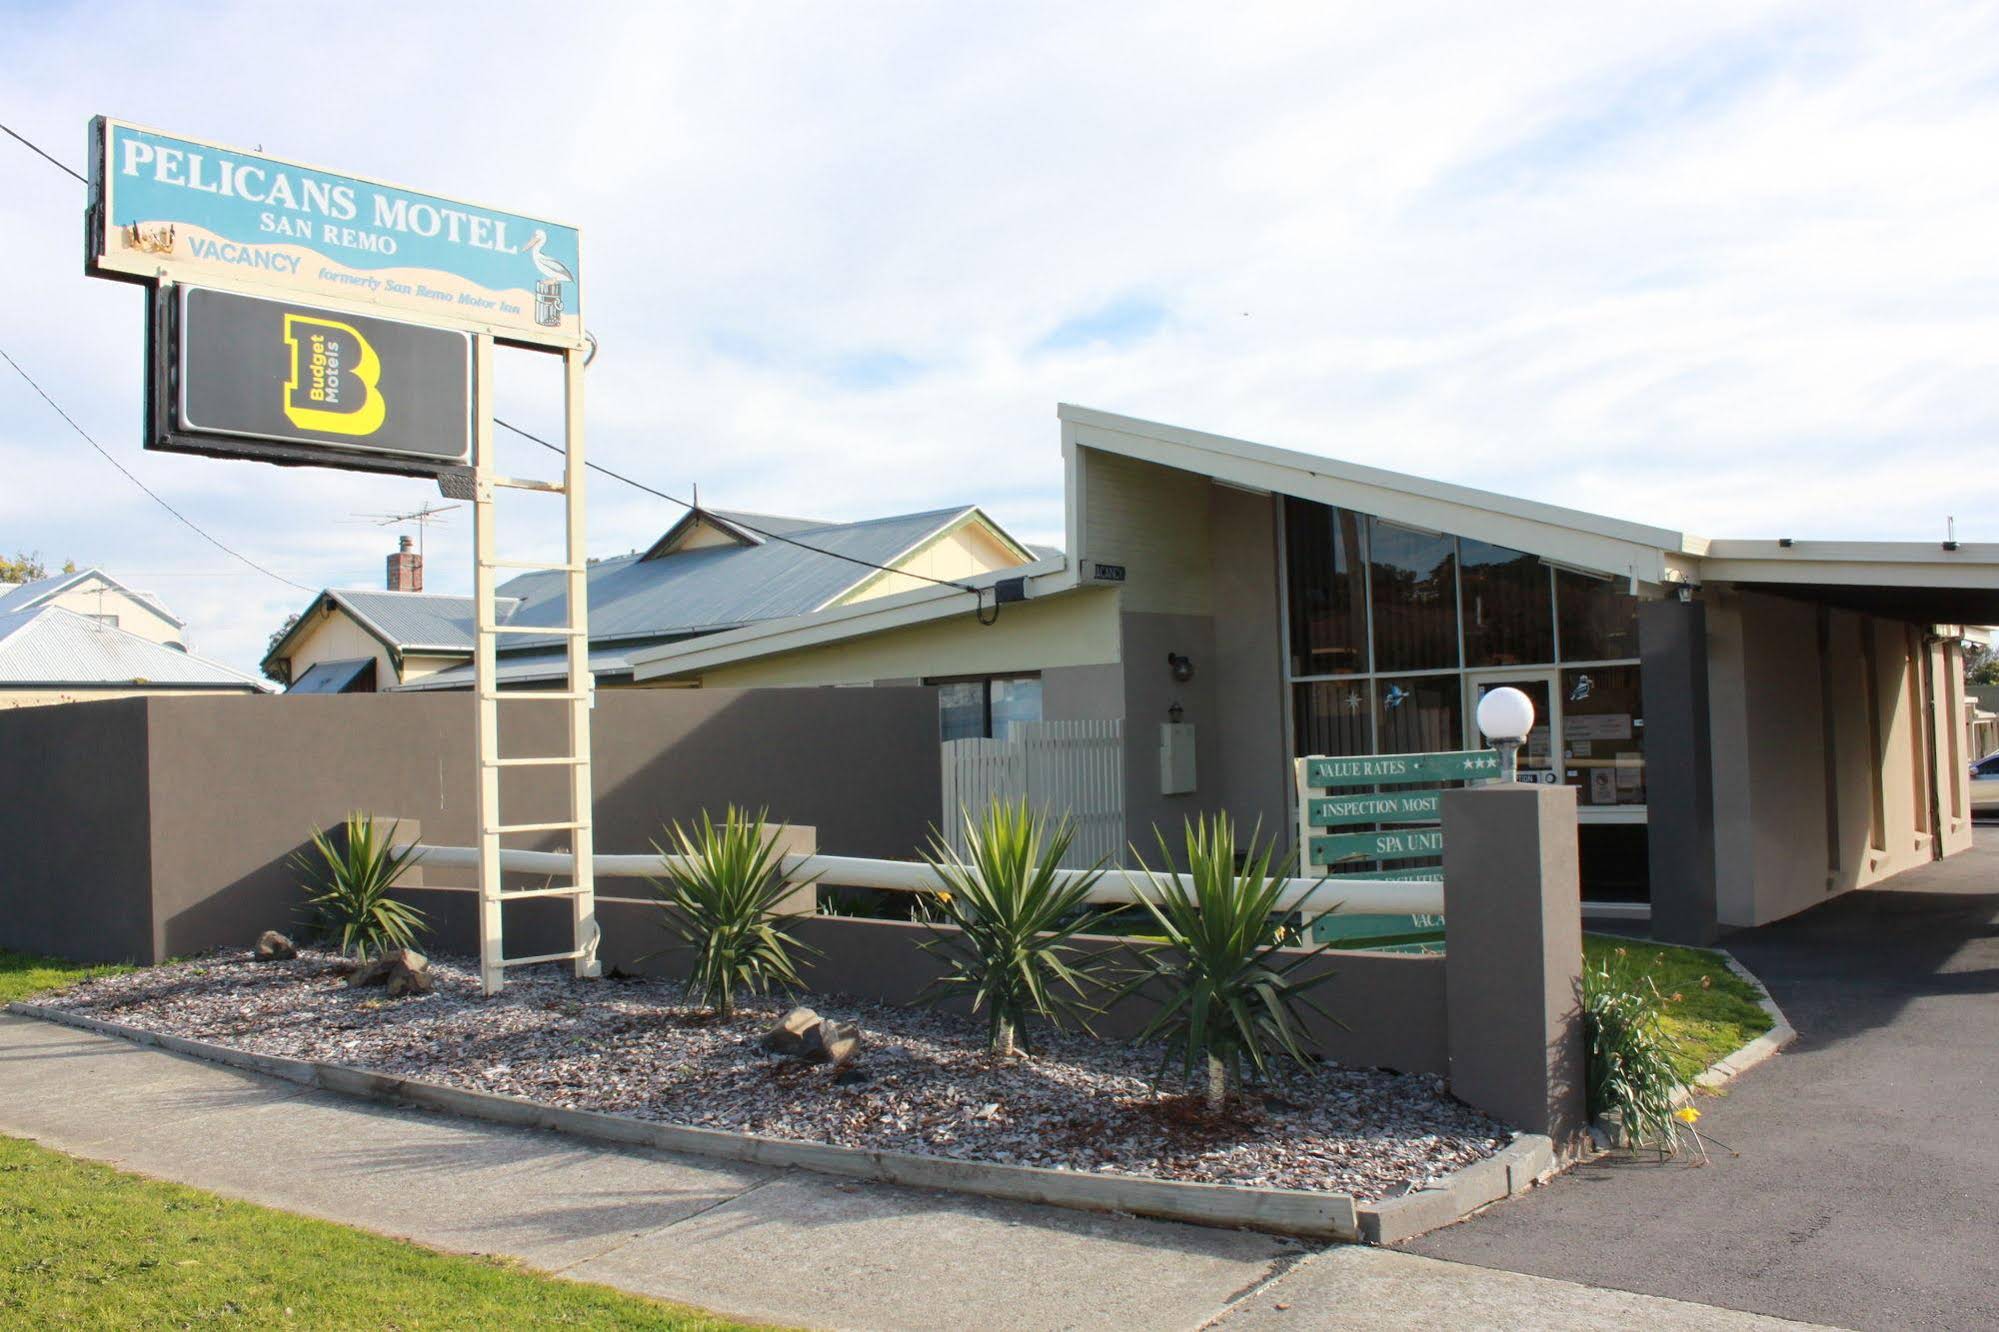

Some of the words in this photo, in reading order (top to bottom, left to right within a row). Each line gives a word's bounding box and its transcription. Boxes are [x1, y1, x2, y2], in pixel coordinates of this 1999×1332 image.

[122, 138, 357, 221] PELICANS
[372, 193, 518, 255] MOTEL
[188, 236, 302, 275] VACANCY
[259, 212, 312, 240] SAN
[323, 224, 398, 256] REMO
[318, 267, 382, 291] formerly
[384, 279, 411, 296] San
[416, 285, 454, 303] Remo
[458, 292, 497, 310] Motor
[499, 301, 521, 315] Inn
[309, 334, 327, 401] Budget
[324, 341, 339, 403] Motels
[1319, 762, 1361, 777] VALUE
[1364, 760, 1406, 775] RATES
[1322, 800, 1398, 818] INSPECTION
[1402, 797, 1439, 812] MOST
[1376, 836, 1404, 853] SPA
